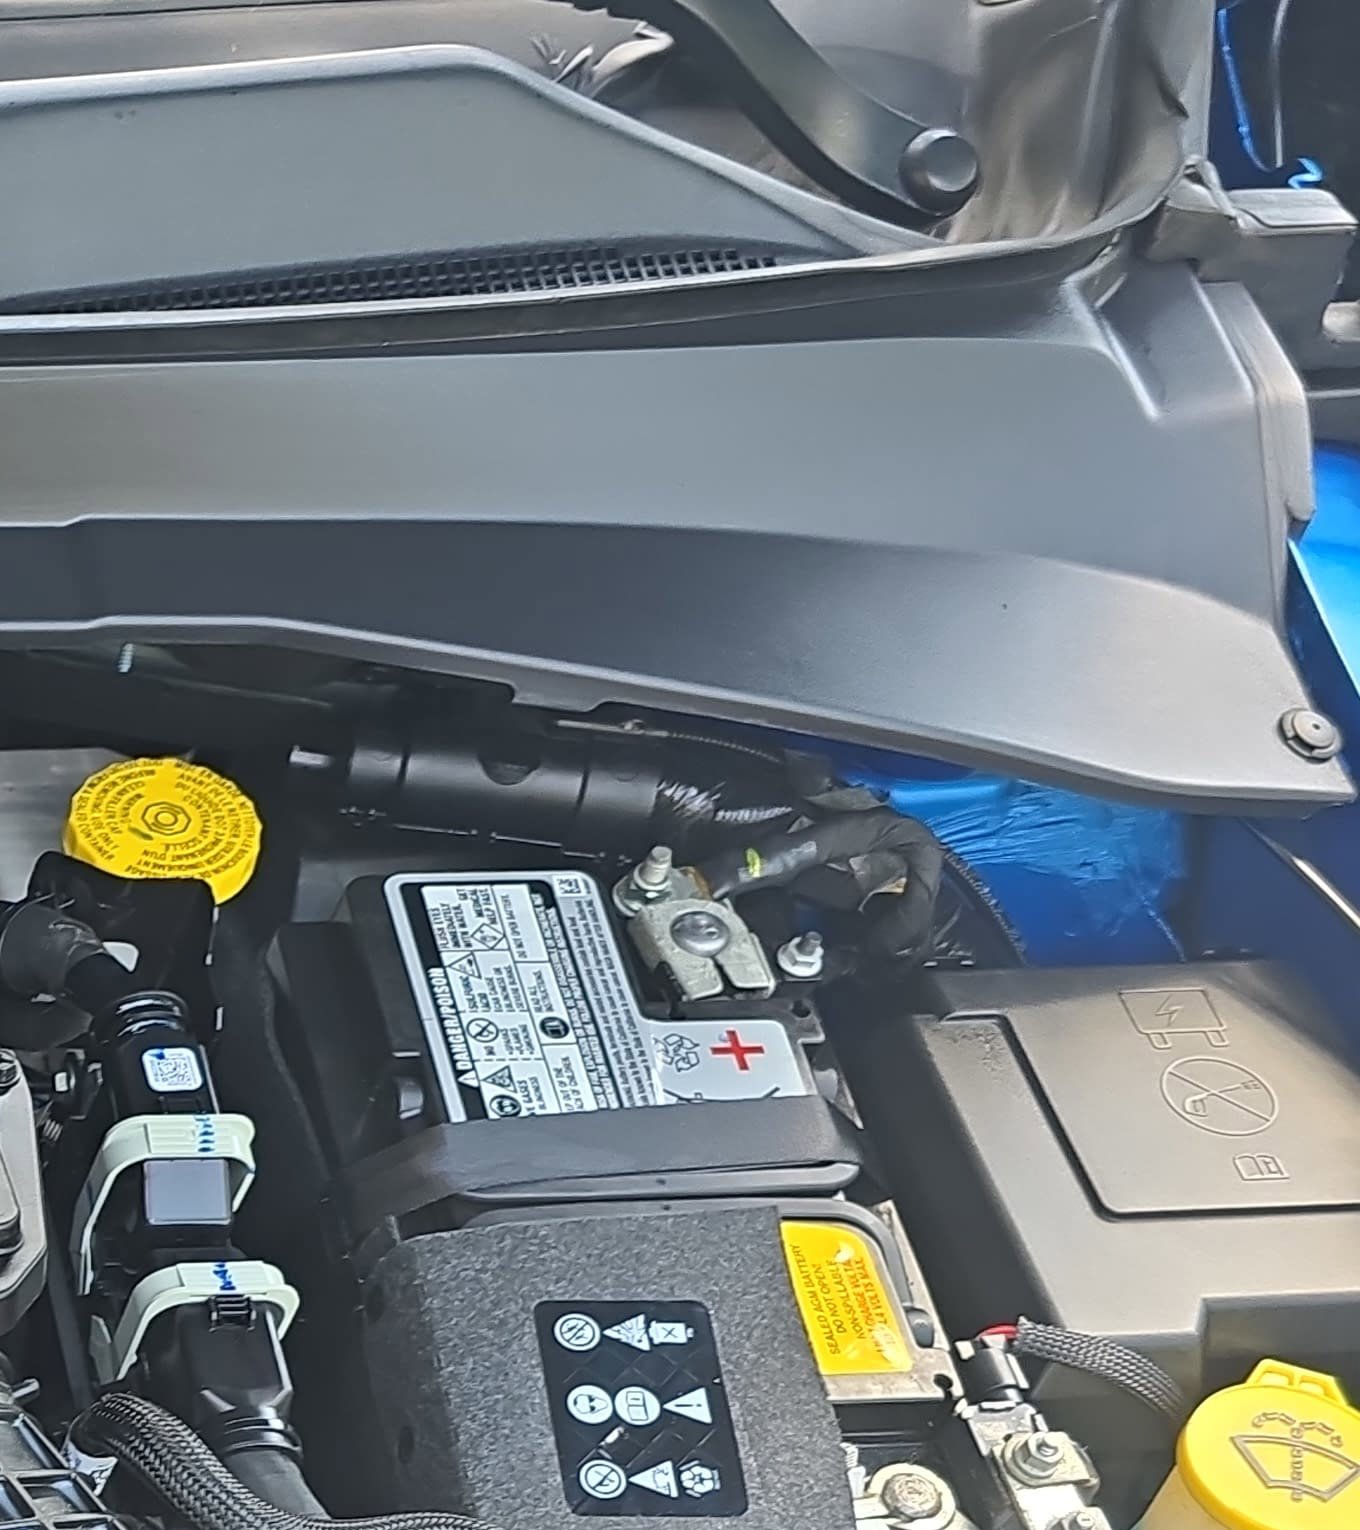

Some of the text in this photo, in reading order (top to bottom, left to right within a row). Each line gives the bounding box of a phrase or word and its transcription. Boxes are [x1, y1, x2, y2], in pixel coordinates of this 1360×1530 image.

[429, 967, 470, 1070] DANGER/POISON
[790, 1243, 813, 1287] BATTERY
[823, 1296, 839, 1316] NOT
[816, 1315, 840, 1354] SEALED
[832, 1319, 846, 1333] DO
